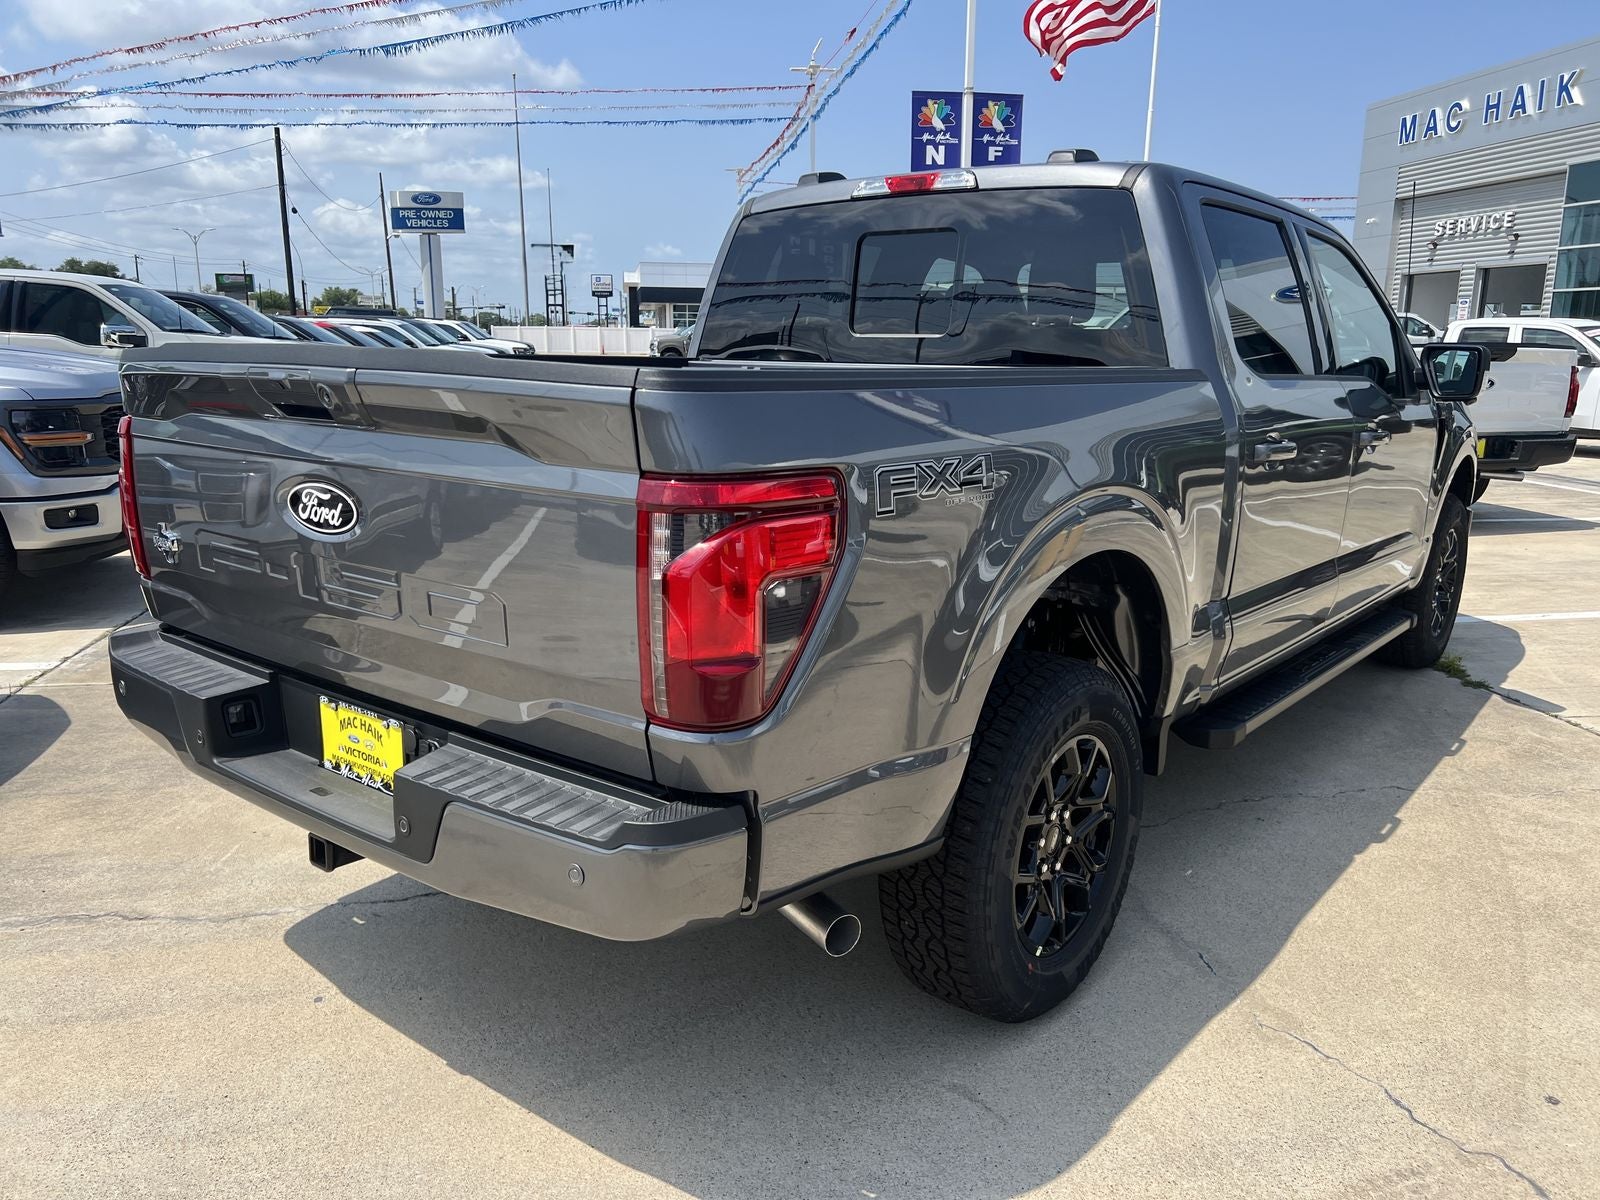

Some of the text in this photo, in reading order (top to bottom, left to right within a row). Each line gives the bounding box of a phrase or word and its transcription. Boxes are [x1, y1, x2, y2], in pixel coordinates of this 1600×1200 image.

[1398, 69, 1582, 146] MAC HAIK
[925, 145, 946, 166] N
[988, 146, 1004, 162] F
[416, 194, 435, 203] Ford
[399, 209, 454, 219] PRE-OWNED
[405, 219, 449, 228] VEHICLES
[1434, 211, 1517, 236] SERVICE
[873, 452, 995, 518] FX4
[298, 488, 344, 528] Ford
[196, 528, 511, 649] F-150
[339, 717, 358, 732] MAC
[360, 718, 384, 746] HAIK
[343, 744, 381, 767] VICTORIA
[339, 763, 385, 790] Mac Haik
